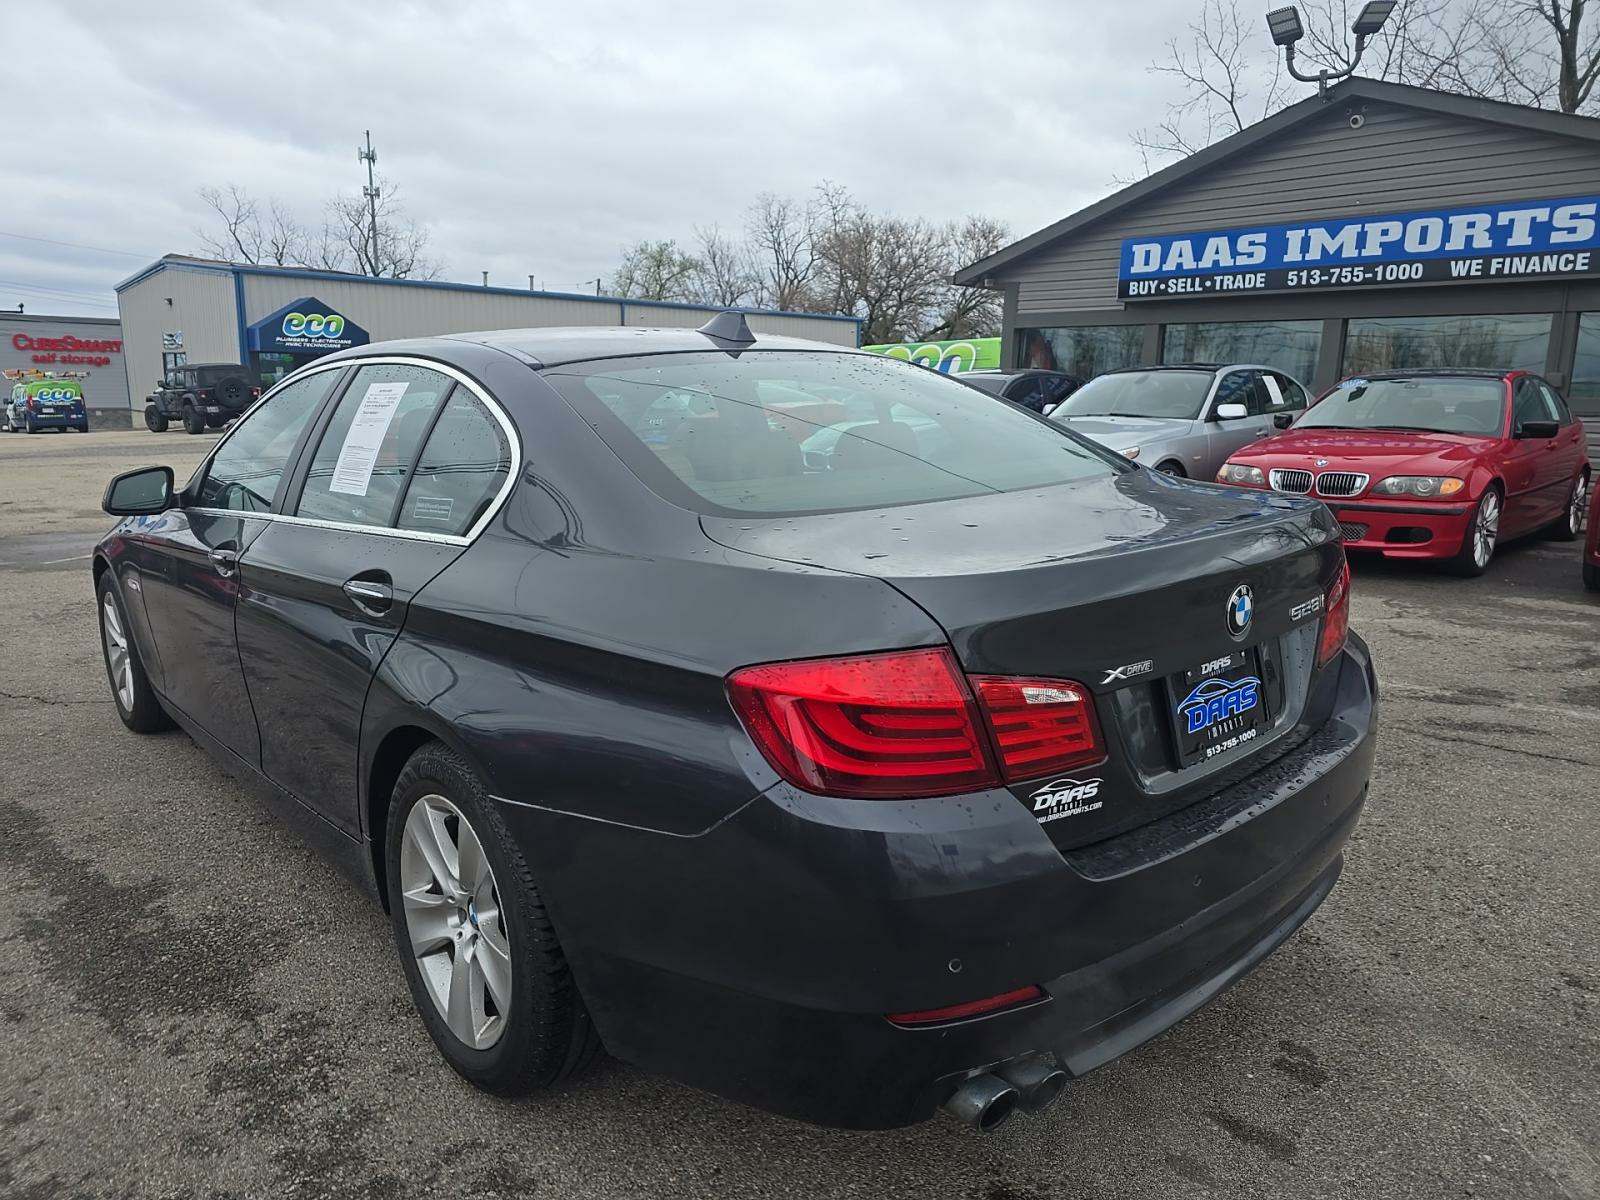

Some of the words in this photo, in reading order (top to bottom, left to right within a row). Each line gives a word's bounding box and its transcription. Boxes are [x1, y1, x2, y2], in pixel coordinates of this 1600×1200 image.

[1130, 233, 1267, 273] DAAS
[1283, 203, 1597, 262] IMPORTS
[1129, 280, 1159, 296] BUY
[1167, 278, 1203, 293] SELL
[1214, 273, 1266, 290] TRADE
[1287, 262, 1424, 286] 513-755-1000
[1450, 259, 1483, 277] WE
[1490, 252, 1591, 275] FINANCE
[282, 312, 345, 339] eco
[32, 352, 57, 364] self
[60, 353, 111, 367] storage
[37, 388, 76, 402] eco
[1201, 655, 1231, 675] DAAS
[1184, 682, 1258, 734] DAAS
[1206, 728, 1257, 758] 513-755-1000
[1033, 781, 1100, 811] DAAS
